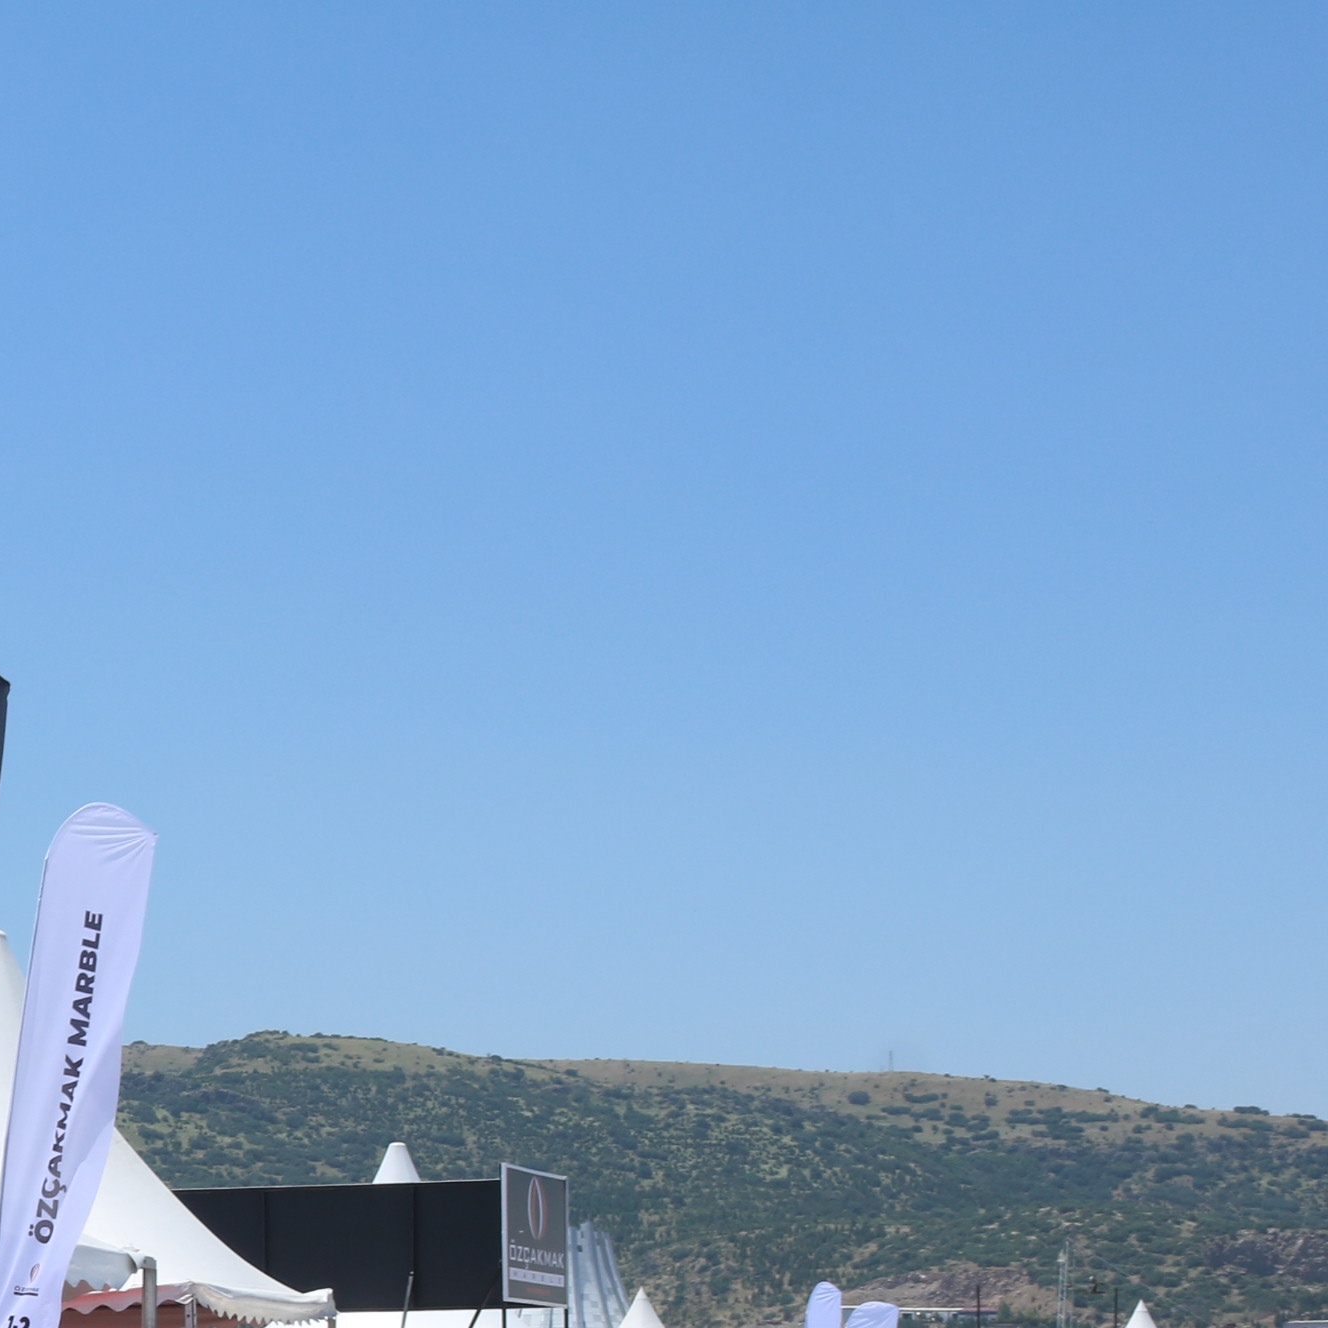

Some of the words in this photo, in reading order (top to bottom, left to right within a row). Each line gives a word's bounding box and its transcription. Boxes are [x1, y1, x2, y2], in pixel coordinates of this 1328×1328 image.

[28, 1053, 85, 1245] ÖZÇAKMAK
[67, 909, 104, 1048] MARBLE
[509, 1239, 565, 1270] ÖZÇAKMAK
